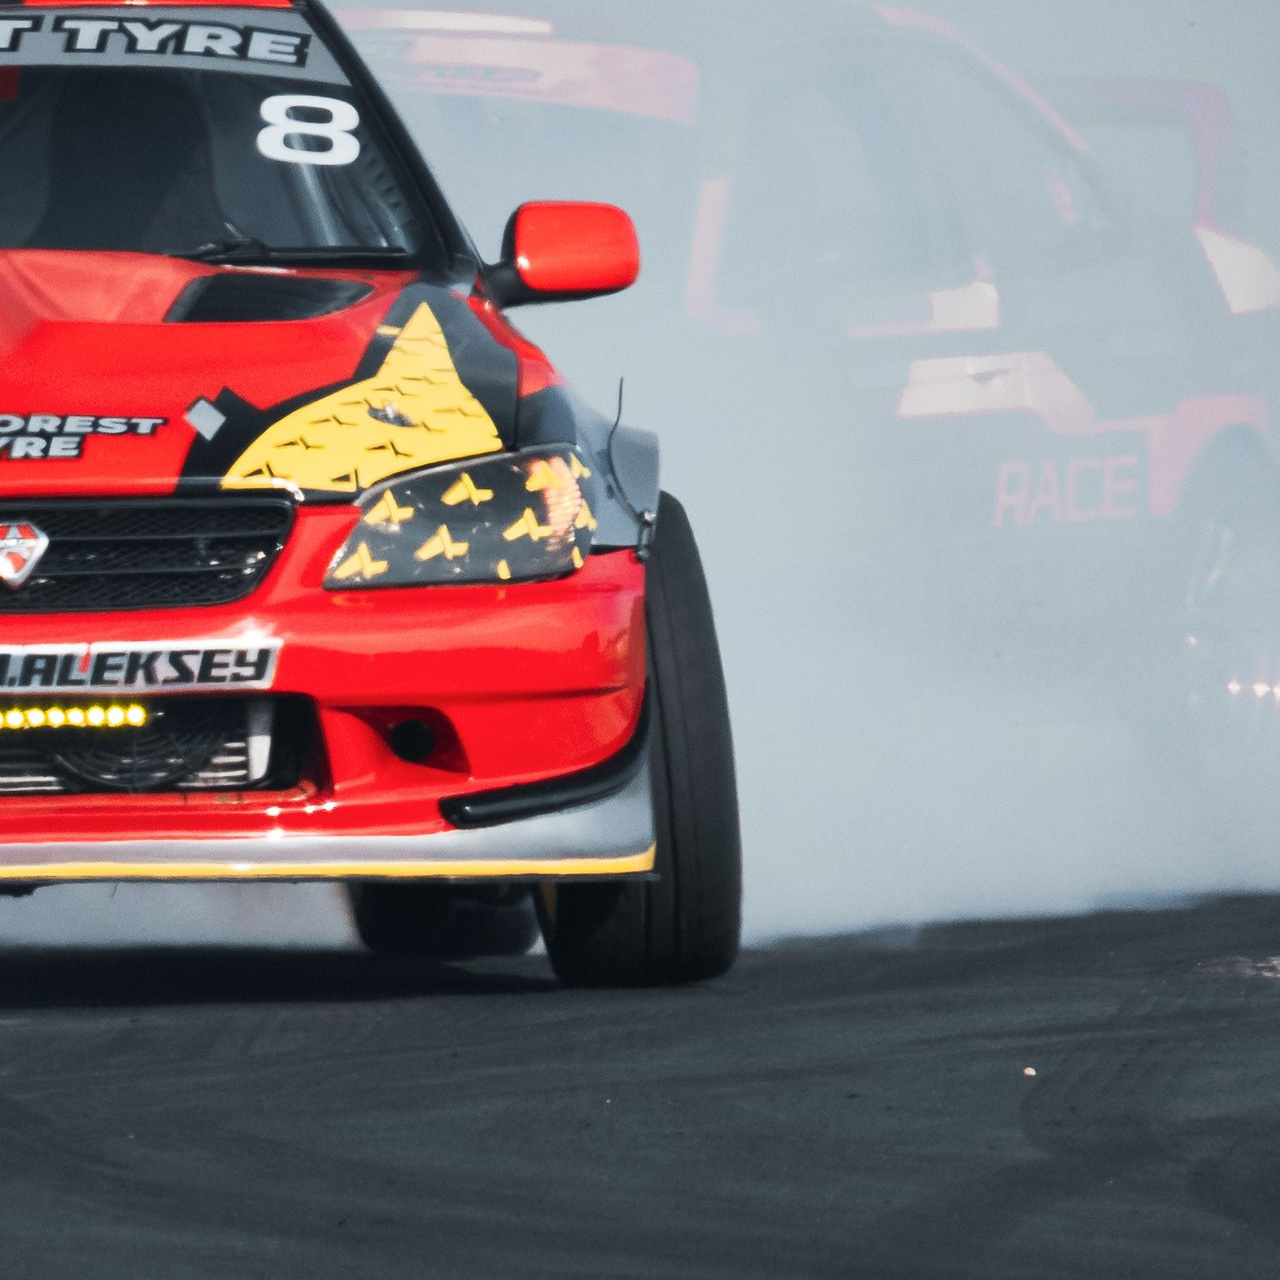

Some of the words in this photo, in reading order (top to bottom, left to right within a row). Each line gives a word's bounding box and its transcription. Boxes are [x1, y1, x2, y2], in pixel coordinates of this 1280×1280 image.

[62, 20, 302, 64] TYRE
[256, 94, 361, 166] 8
[994, 455, 1139, 528] RACE
